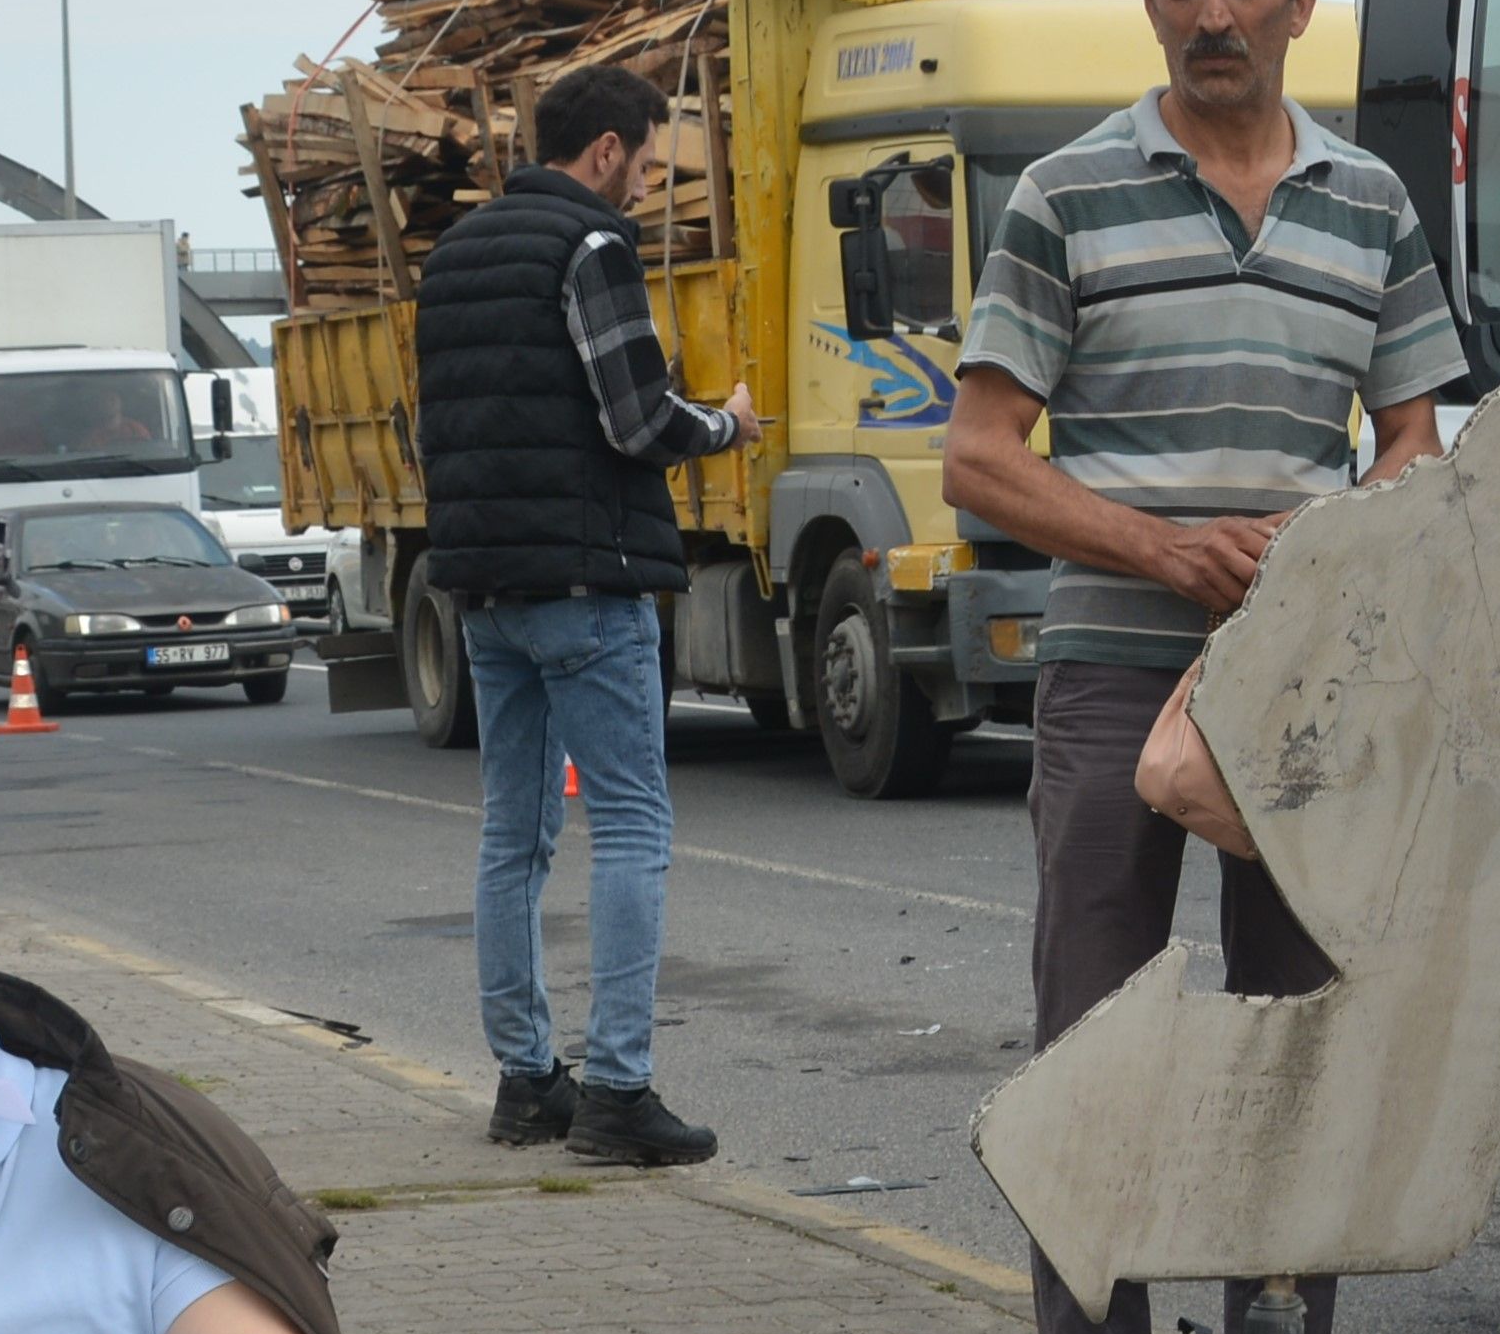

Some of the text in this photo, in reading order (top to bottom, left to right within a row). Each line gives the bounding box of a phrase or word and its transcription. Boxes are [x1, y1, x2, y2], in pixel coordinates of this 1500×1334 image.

[156, 644, 227, 663] 55 RV 977
